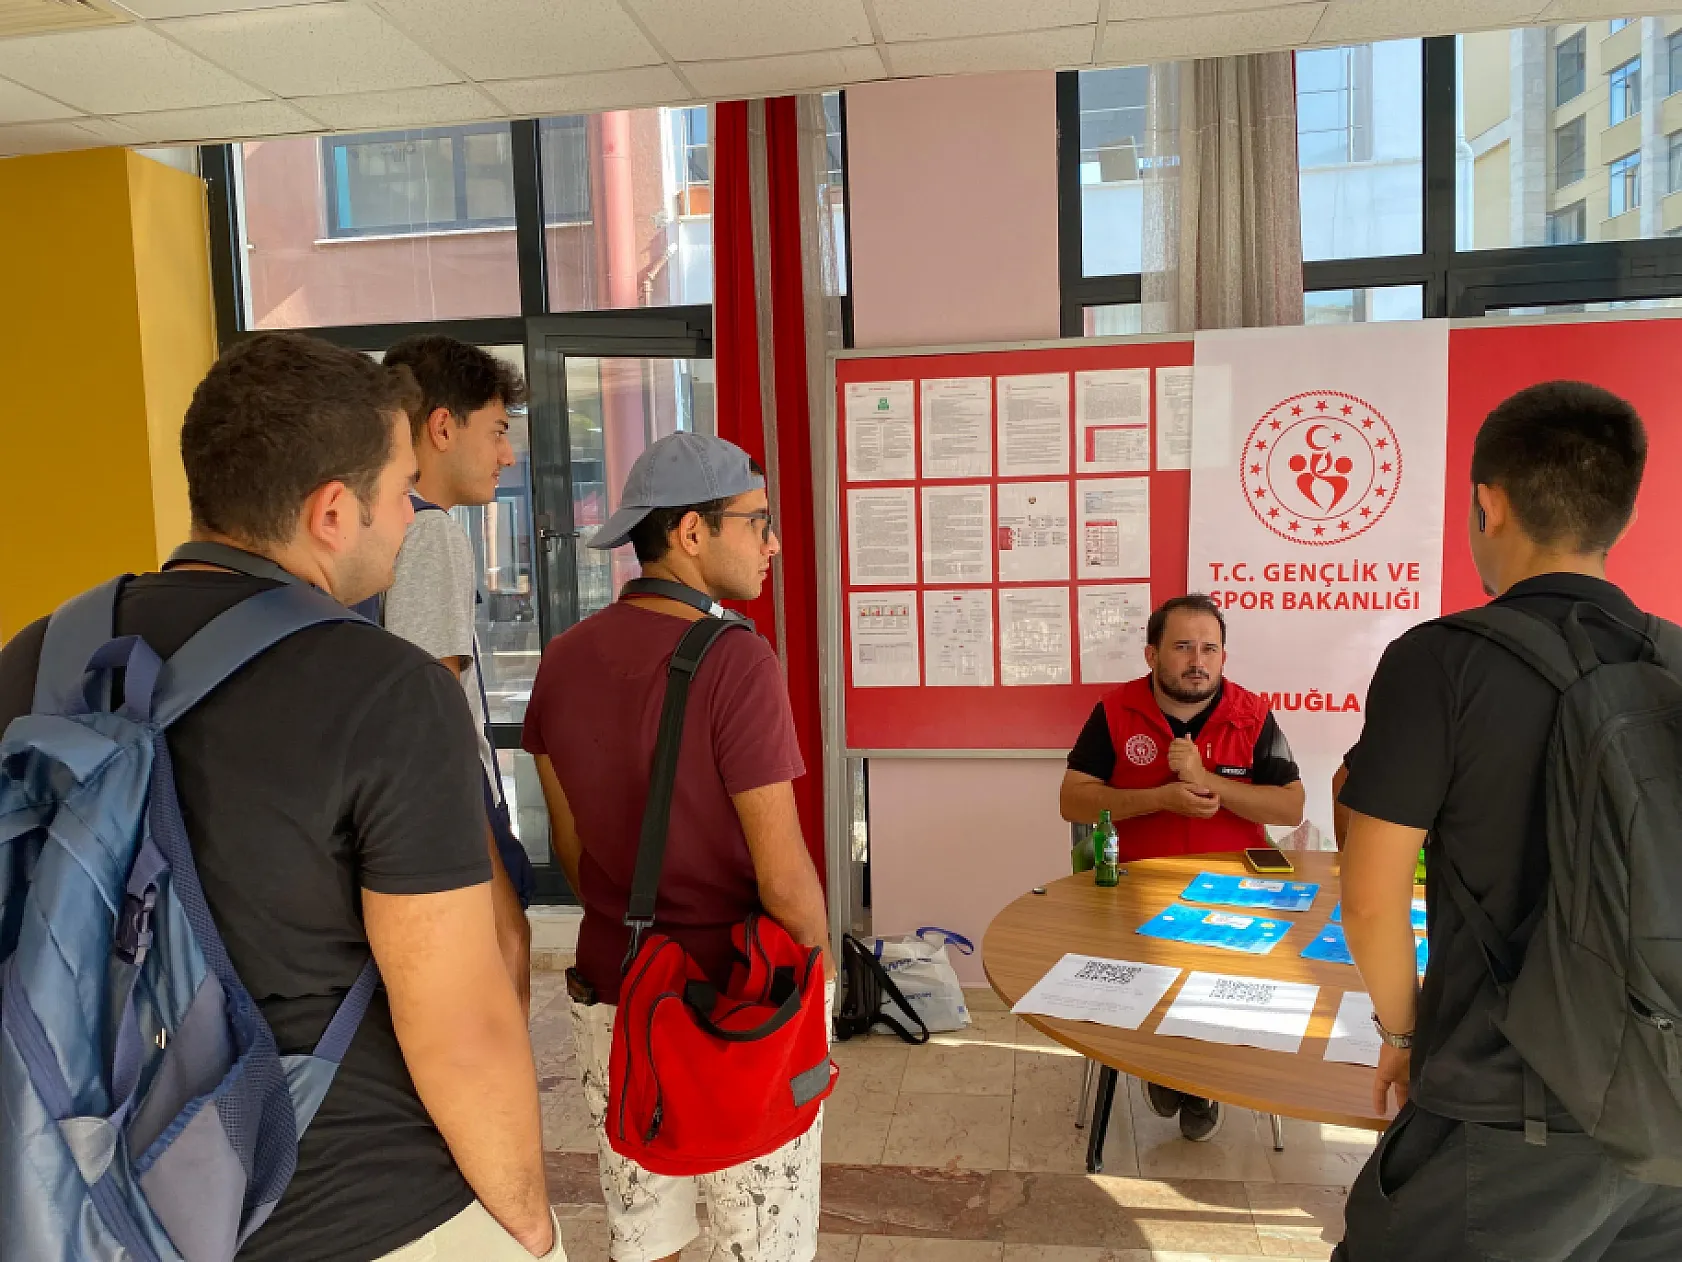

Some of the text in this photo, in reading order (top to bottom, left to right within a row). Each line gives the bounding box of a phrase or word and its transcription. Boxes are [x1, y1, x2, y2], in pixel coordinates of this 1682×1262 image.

[1209, 559, 1420, 587] T.C. GENÇLİK VE
[1209, 587, 1420, 610] SPOR BAKANLIĞI
[1260, 688, 1361, 712] MUĞLA
